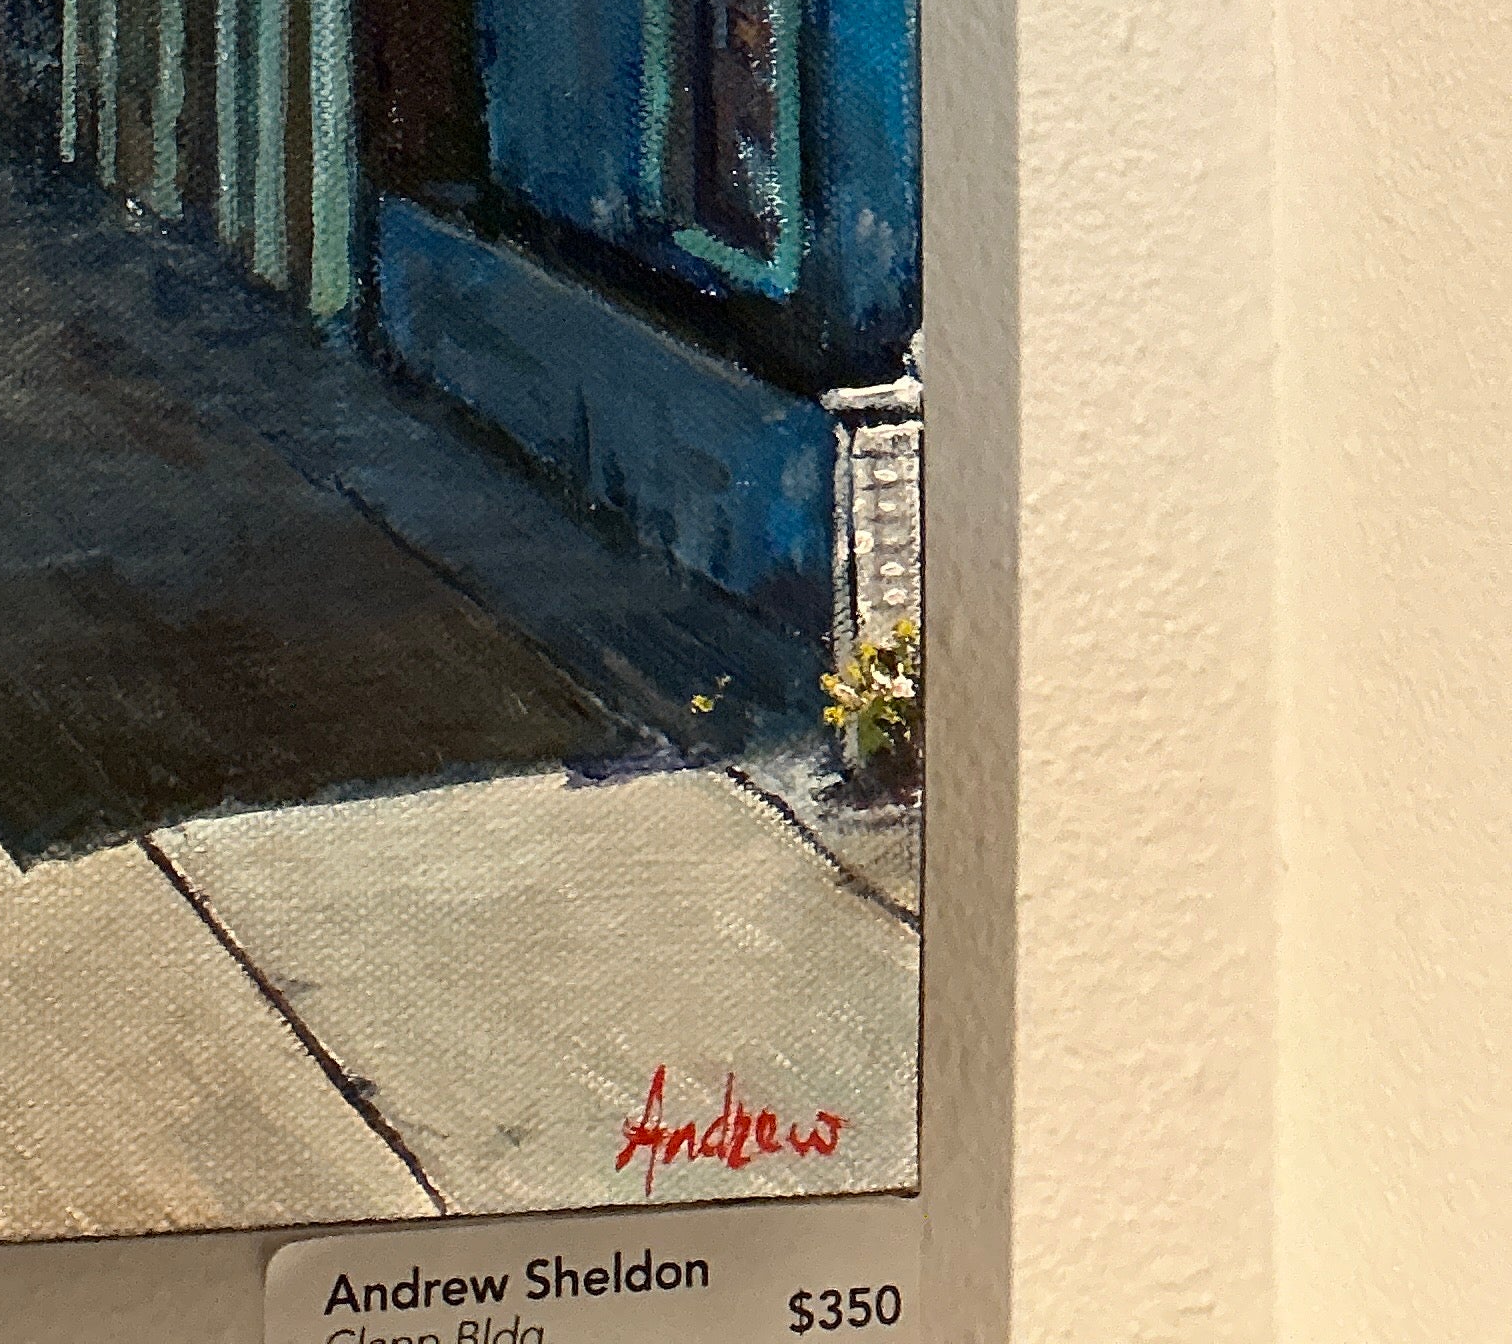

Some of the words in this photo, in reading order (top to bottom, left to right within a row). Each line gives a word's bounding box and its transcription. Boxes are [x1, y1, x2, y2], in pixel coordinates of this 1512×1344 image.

[615, 1064, 850, 1198] Andrew
[324, 1265, 510, 1316] Andrew
[525, 1247, 709, 1300] Sheldon
[789, 1284, 902, 1336] $350
